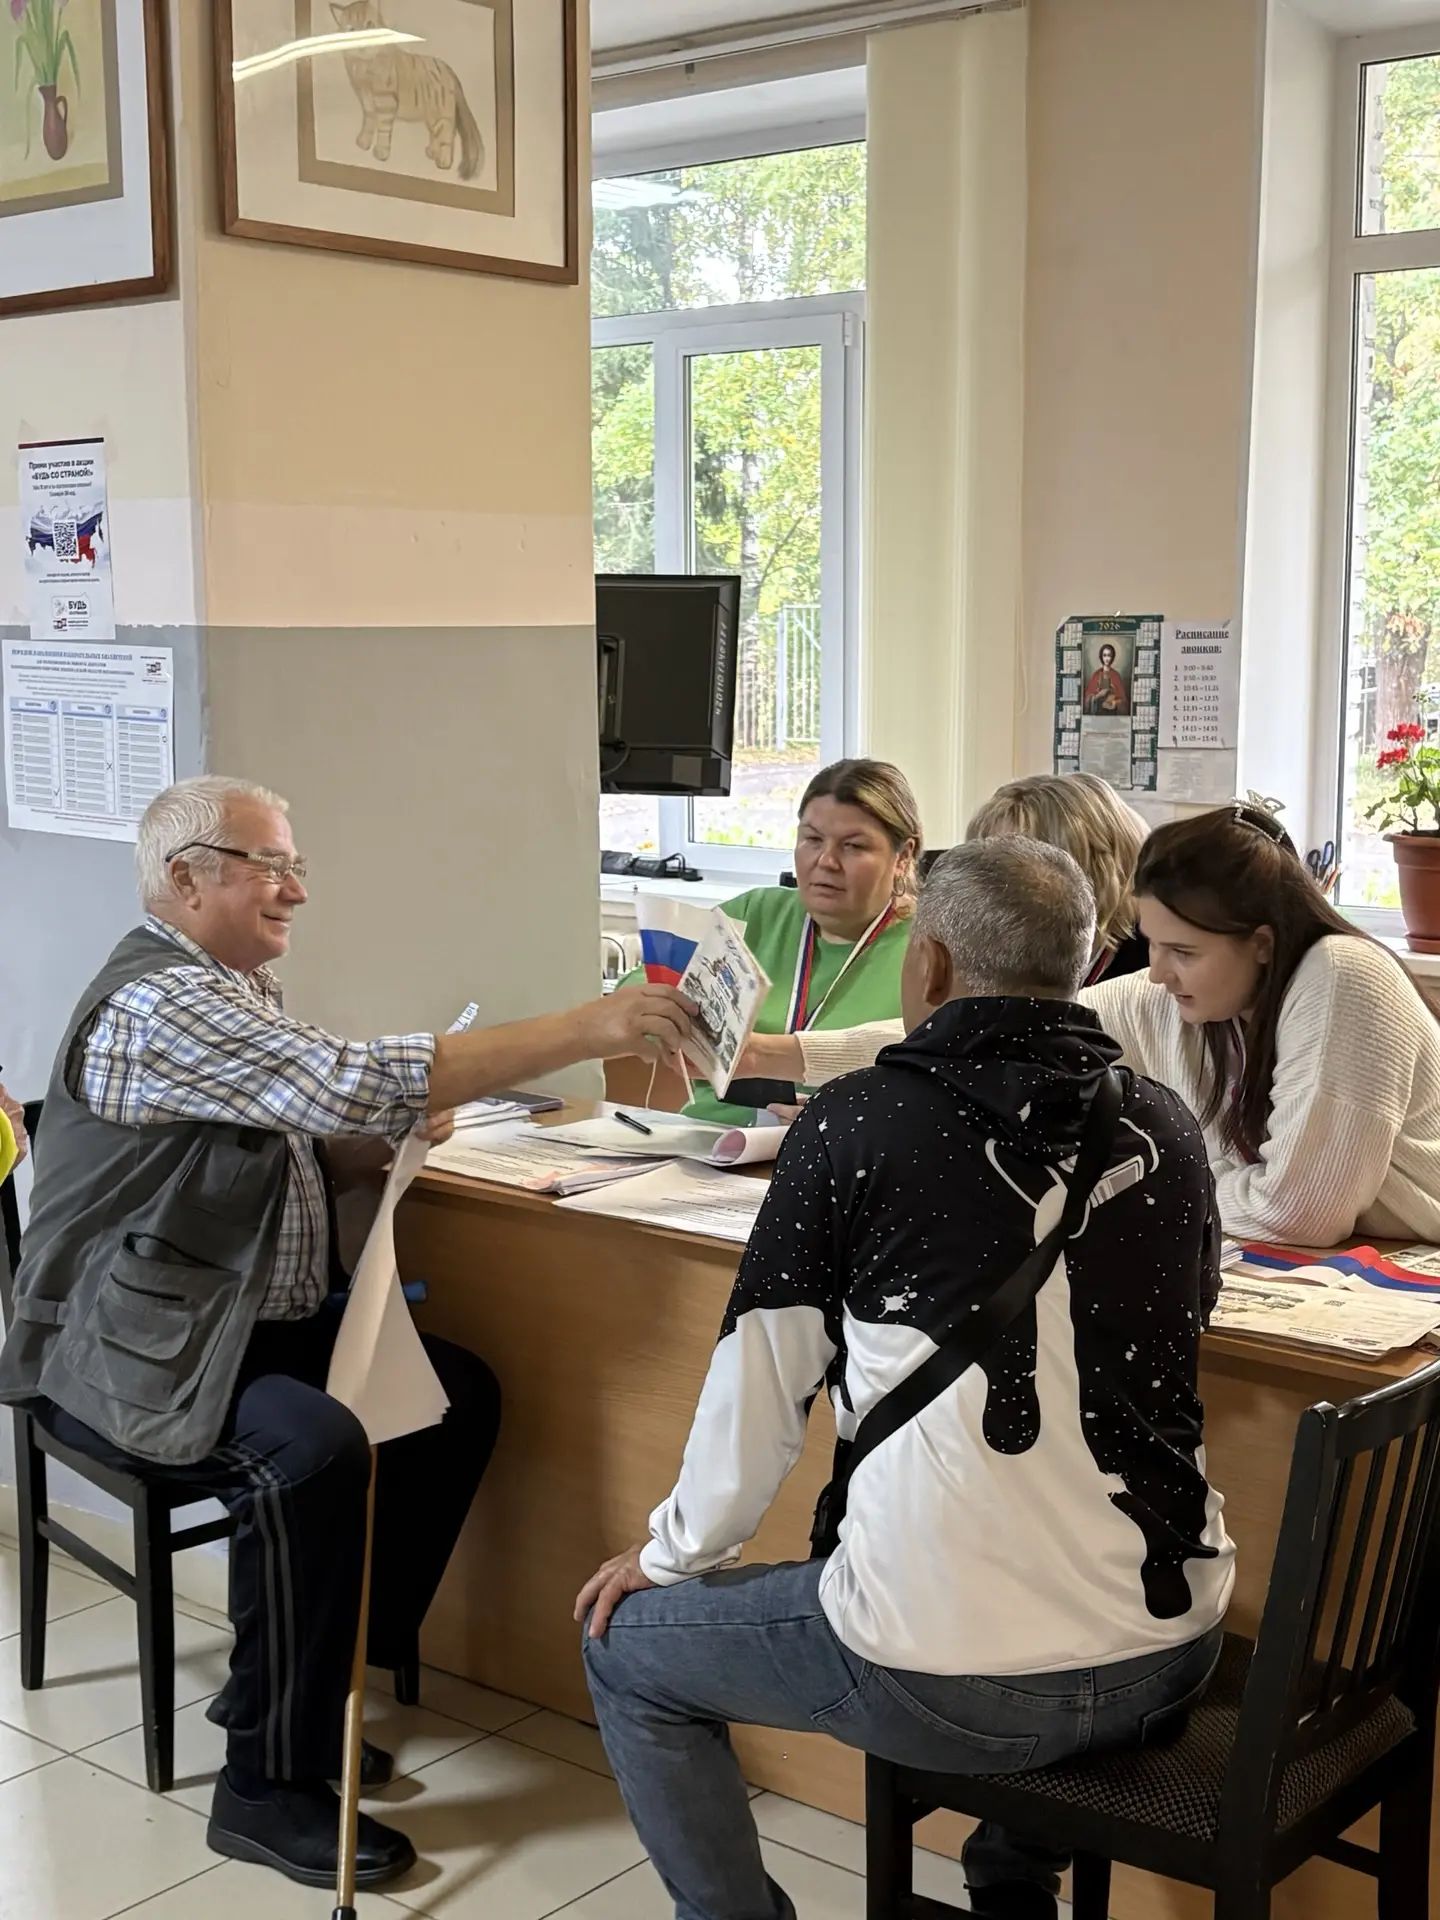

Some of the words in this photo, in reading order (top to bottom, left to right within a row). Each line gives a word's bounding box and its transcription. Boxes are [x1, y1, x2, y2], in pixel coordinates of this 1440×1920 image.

[51, 471, 59, 479] СО
[68, 600, 87, 610] БУДЬ
[1175, 629, 1230, 640] Расписание
